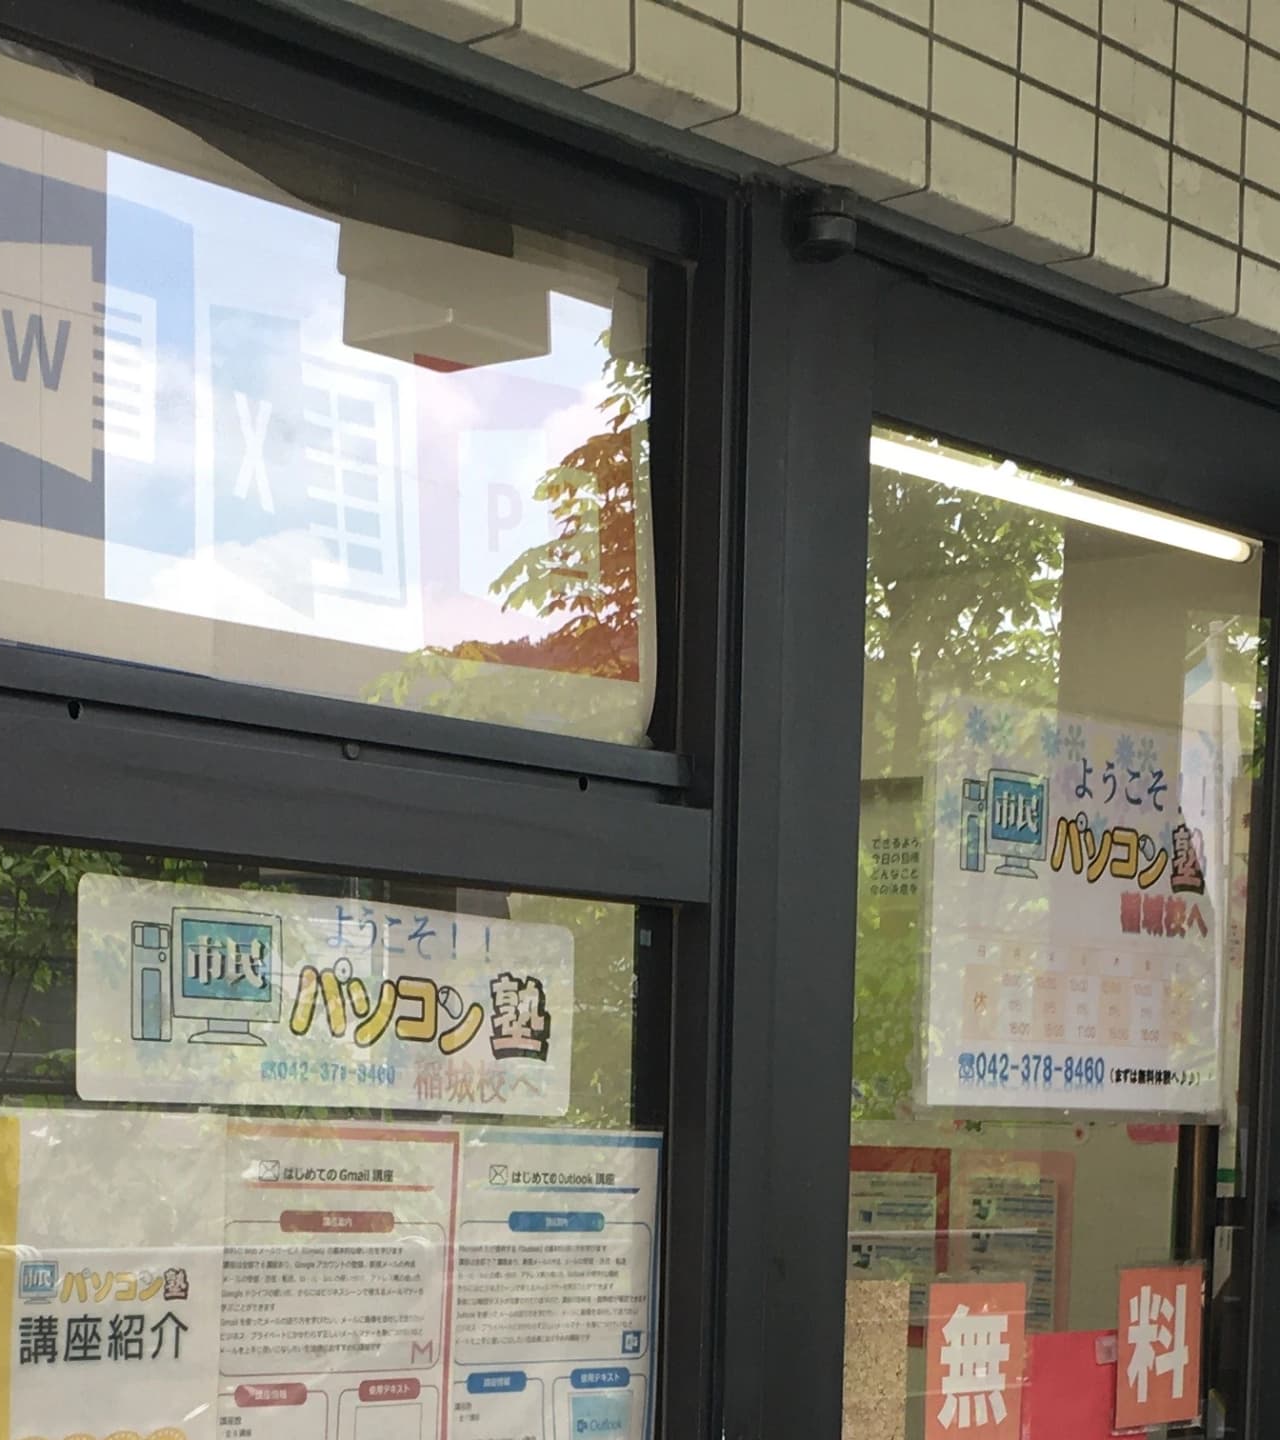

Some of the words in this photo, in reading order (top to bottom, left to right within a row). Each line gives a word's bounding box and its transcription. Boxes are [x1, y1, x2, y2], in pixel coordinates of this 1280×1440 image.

[1, 309, 70, 391] W
[995, 791, 1039, 833] 市民
[1052, 811, 1207, 893] パソコン塾
[188, 938, 269, 987] 市民
[290, 959, 550, 1060] パソコン塾
[976, 1052, 1104, 1084] 042-378-8460
[283, 1169, 337, 1180] はじめての
[339, 1169, 369, 1181] Gmail
[373, 1170, 393, 1181] 講座
[512, 1172, 557, 1183] はじめての
[558, 1174, 592, 1185] Outlook
[596, 1174, 615, 1185] 講座
[60, 1269, 189, 1303] パソコン塾
[20, 1315, 189, 1365] 講座紹介
[938, 1304, 1011, 1429] 無
[1128, 1283, 1190, 1404] 料
